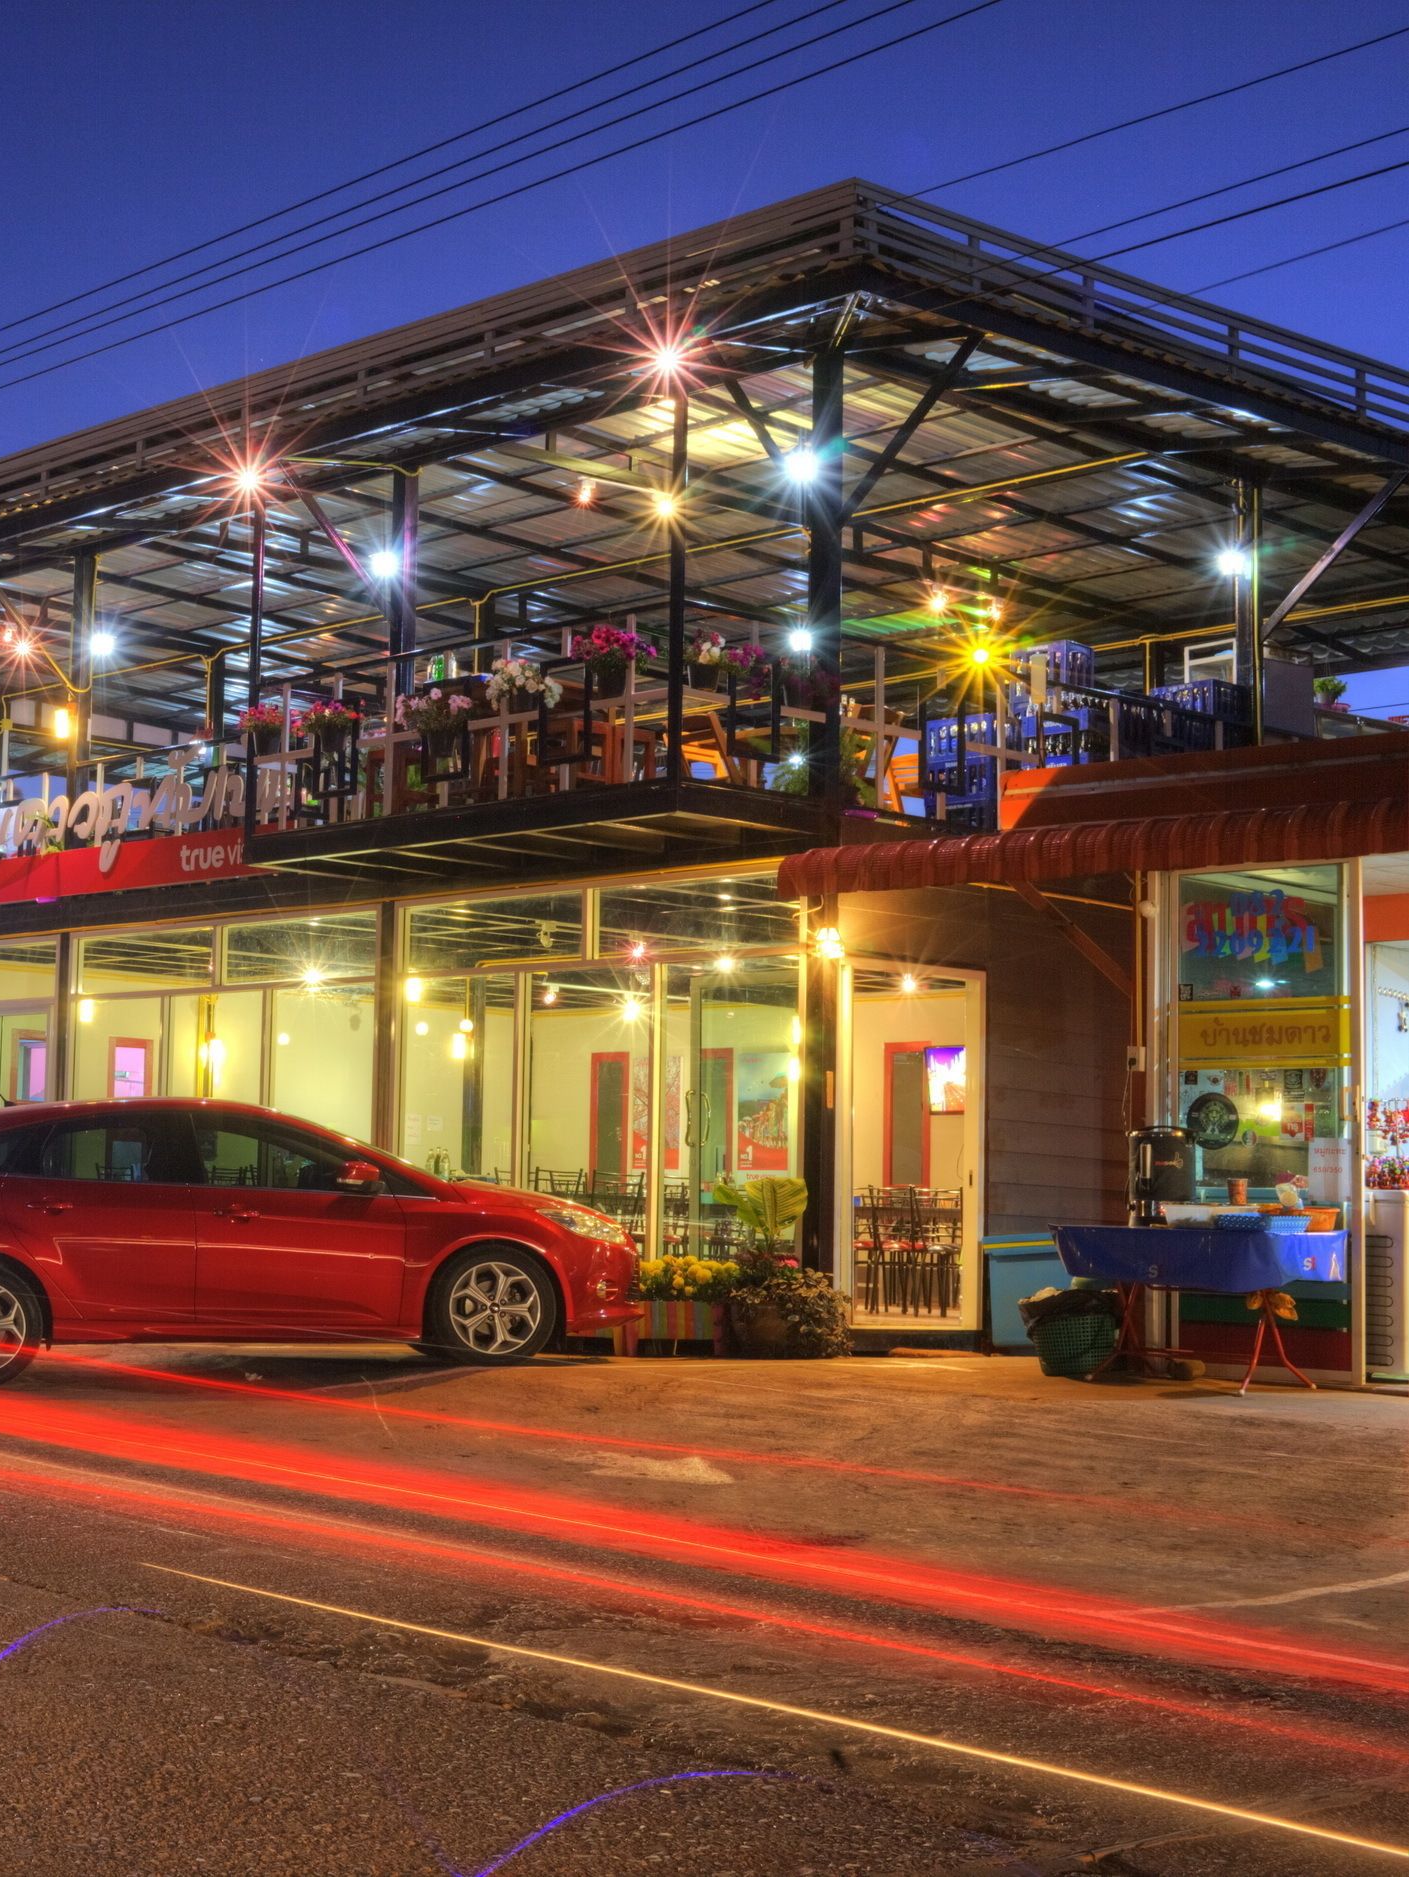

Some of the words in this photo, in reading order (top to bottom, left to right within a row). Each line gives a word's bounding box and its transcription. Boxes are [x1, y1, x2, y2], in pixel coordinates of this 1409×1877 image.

[180, 845, 225, 872] true
[1200, 1017, 1332, 1047] บ้านชมดาว
